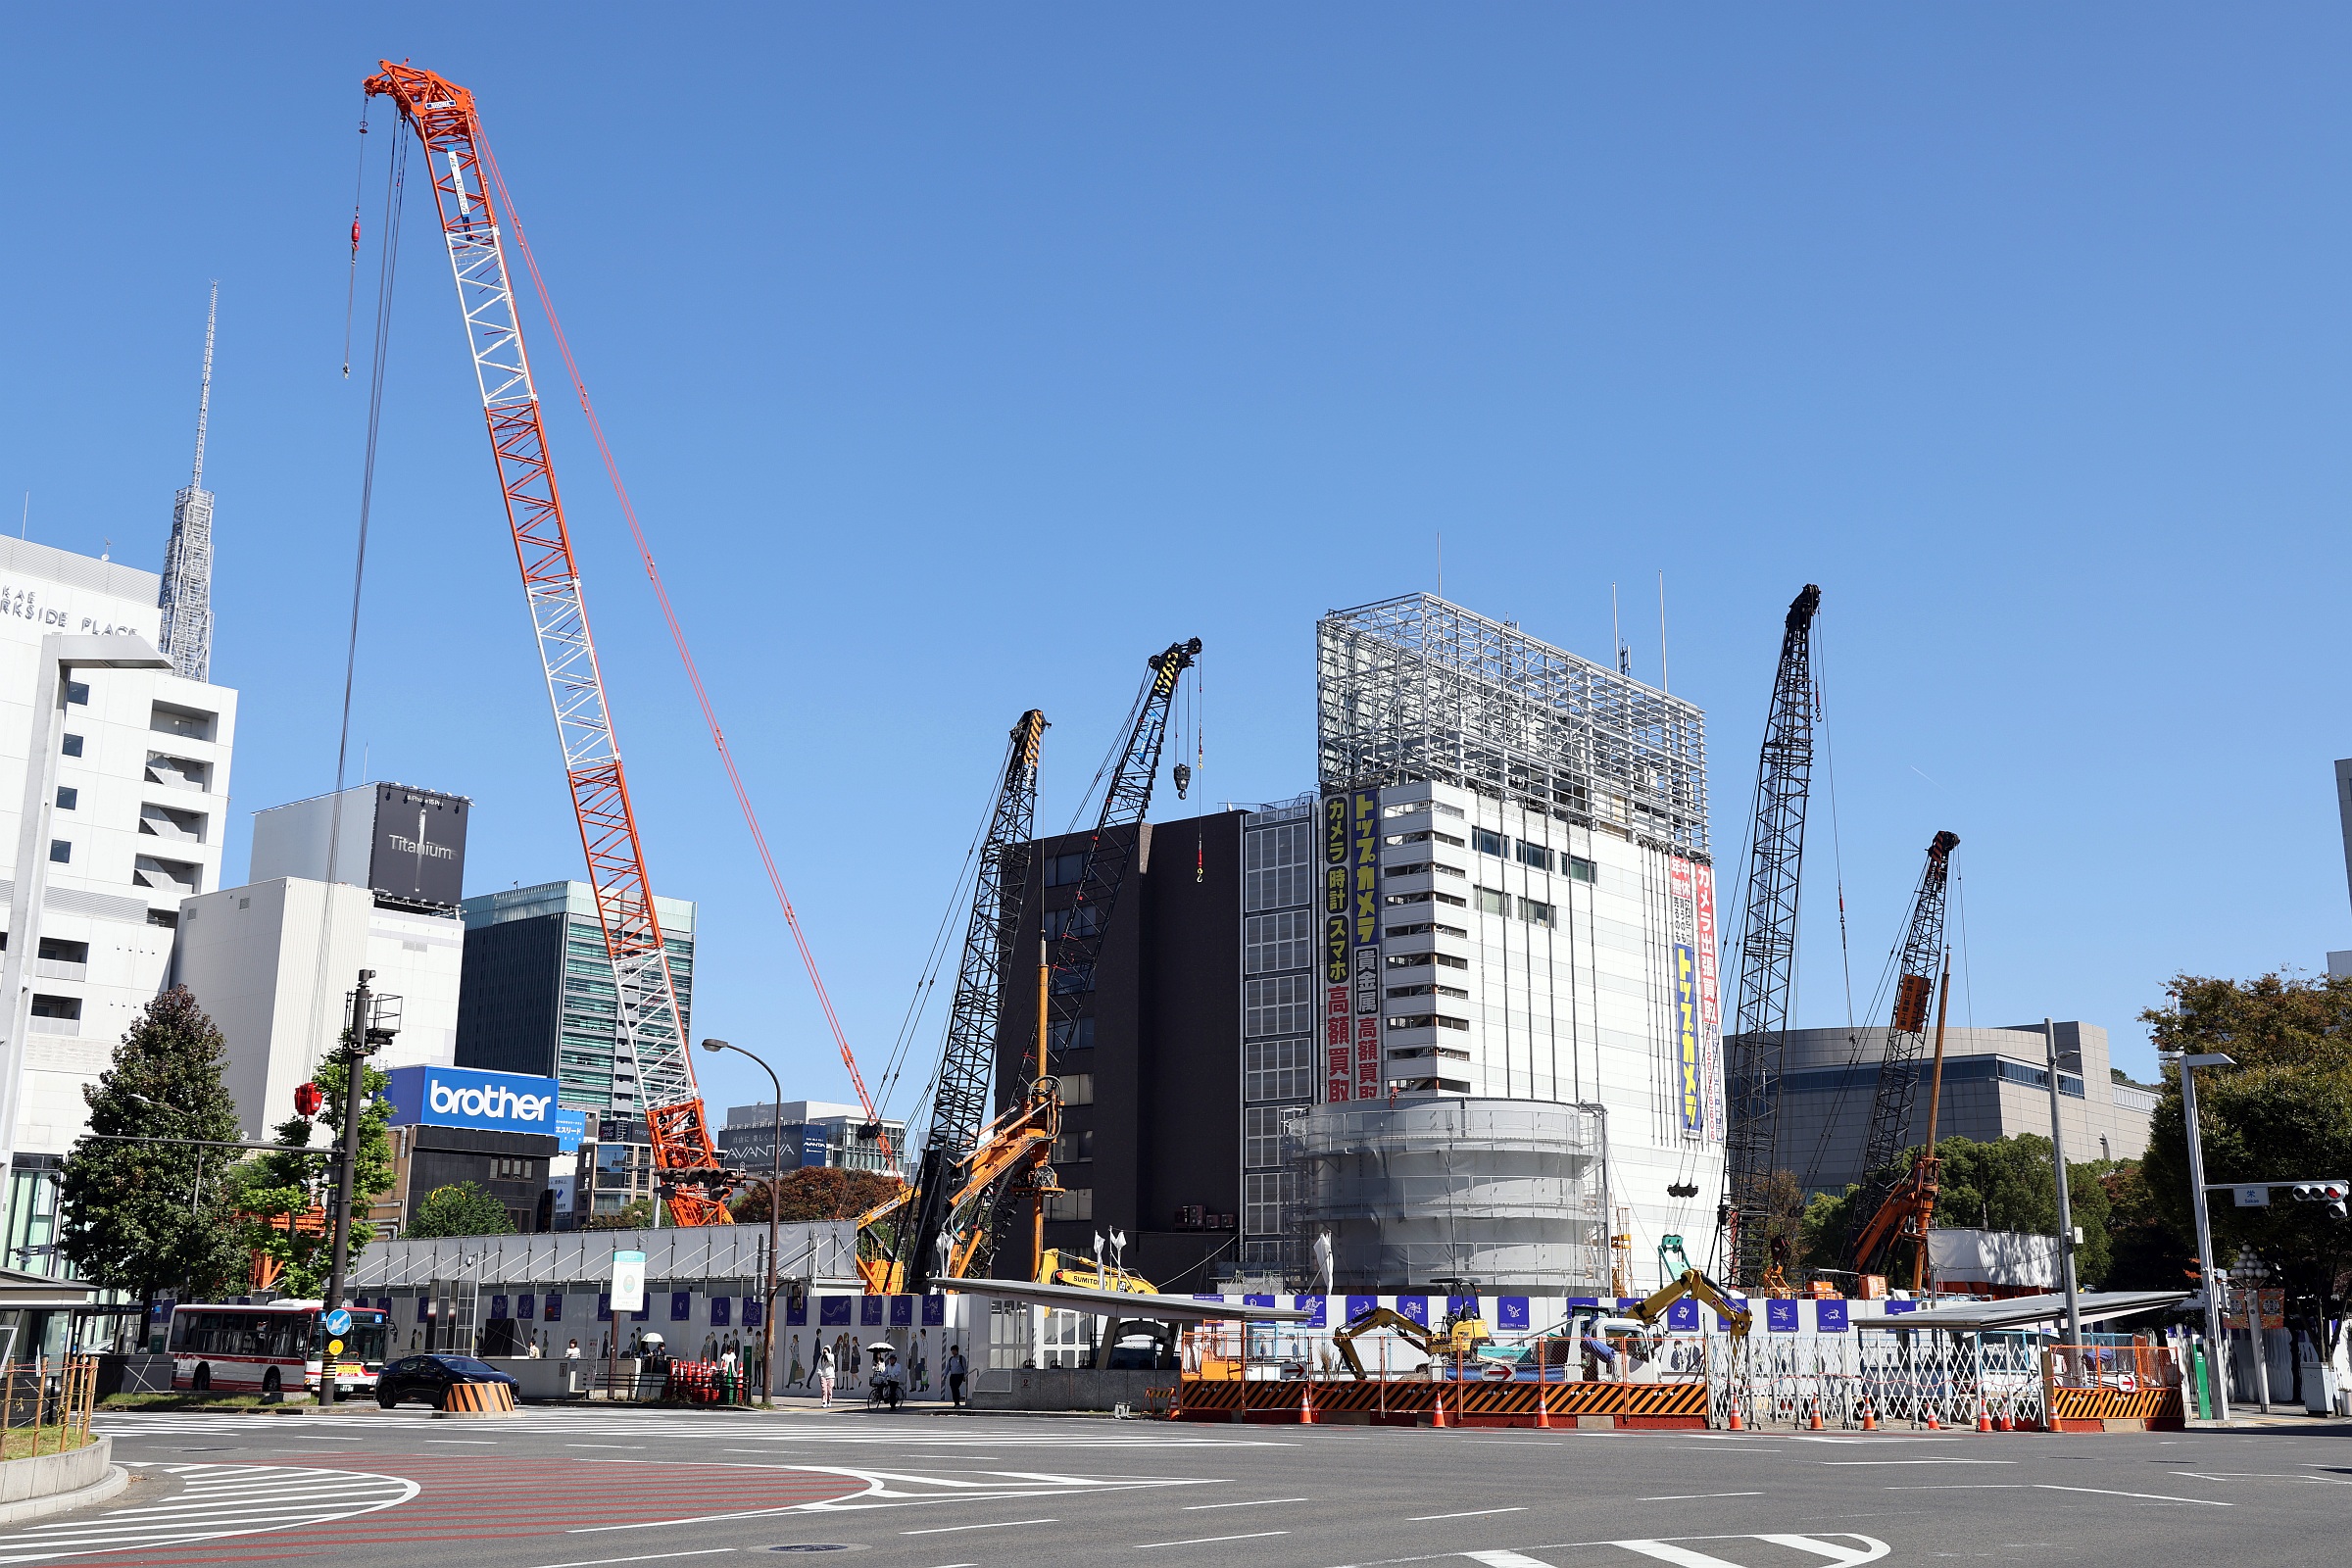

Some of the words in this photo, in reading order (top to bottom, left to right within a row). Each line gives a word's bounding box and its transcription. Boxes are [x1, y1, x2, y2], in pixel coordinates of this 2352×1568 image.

[411, 795, 429, 805] iPhoe
[389, 834, 453, 860] Titanium
[1329, 800, 1346, 862] カメラ
[1329, 868, 1346, 910] 時計
[1355, 794, 1376, 944] トップカメラ
[1329, 919, 1348, 981] スマホ
[1357, 950, 1377, 1012] 貴金属
[1327, 985, 1349, 1102] 高額買取
[1357, 1016, 1378, 1099] 高額買取
[1678, 948, 1697, 1126] トップカメラ
[429, 1079, 552, 1122] brother
[555, 1126, 582, 1136] エスリード
[1073, 1275, 1107, 1287] SUMITOO
[1357, 1317, 1379, 1332] YANMAR
